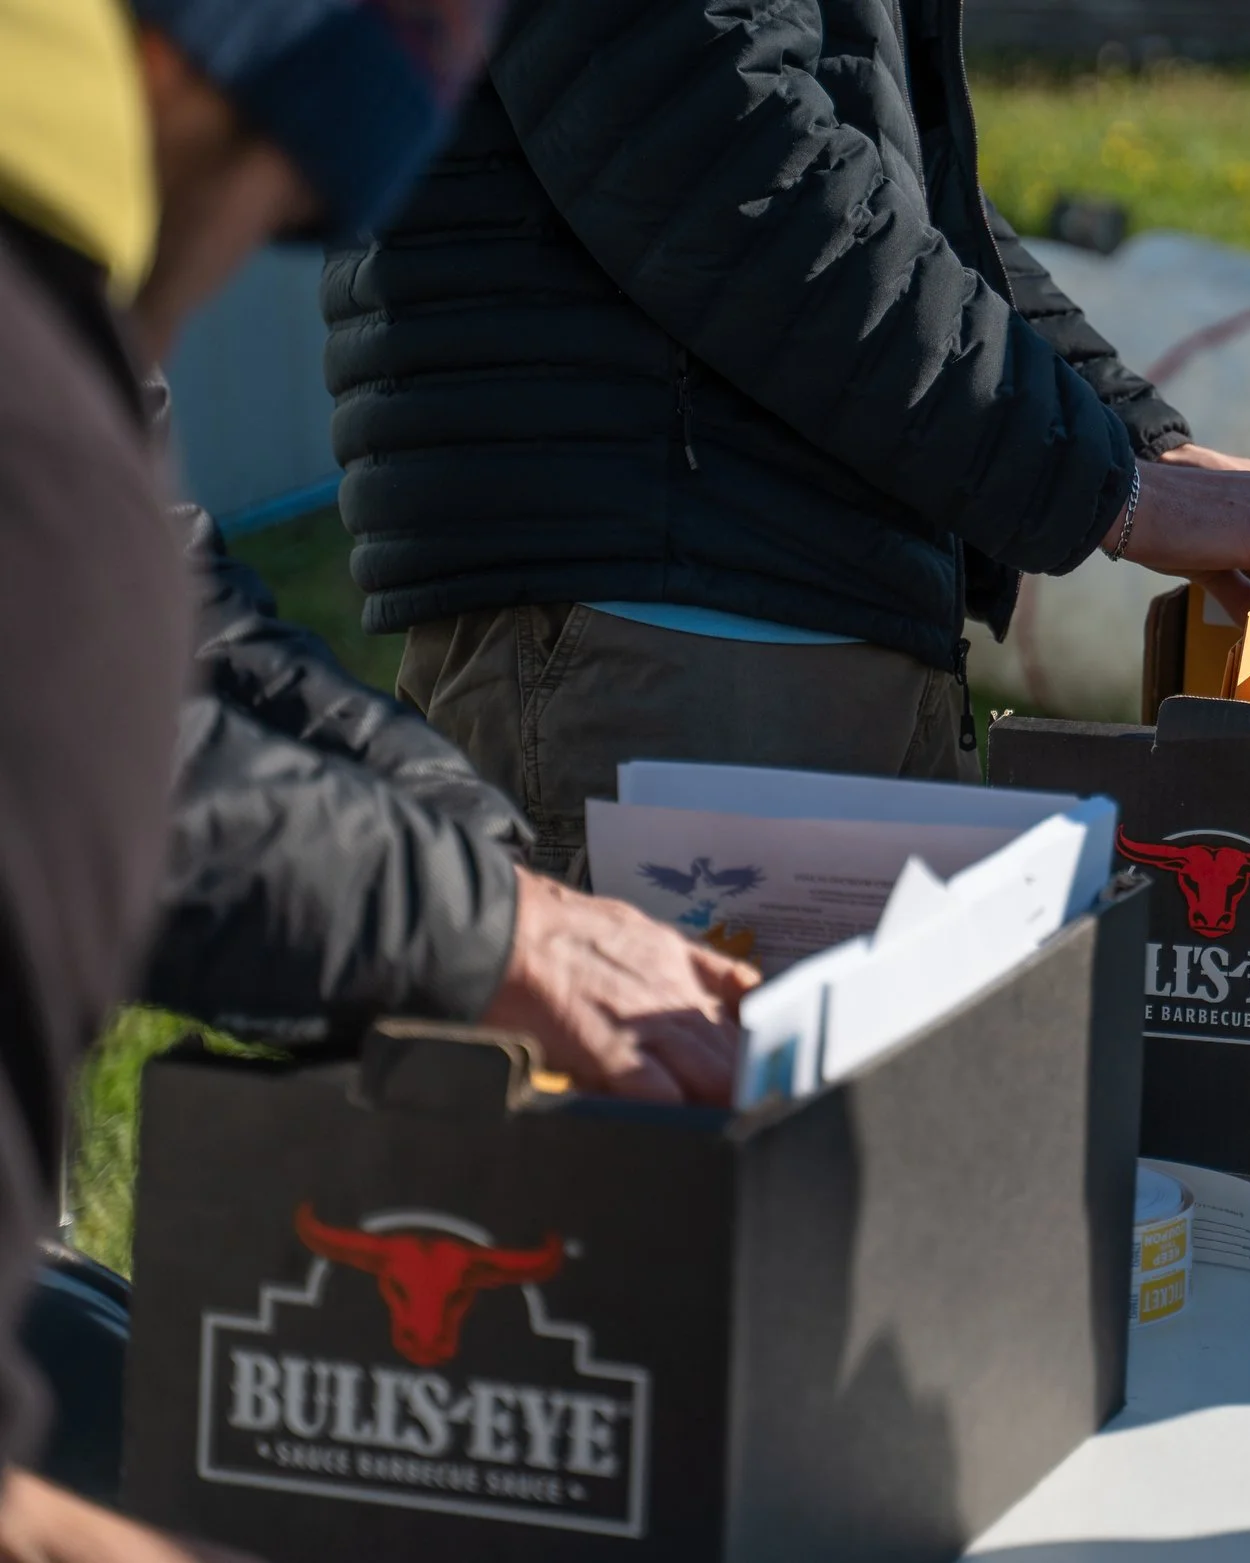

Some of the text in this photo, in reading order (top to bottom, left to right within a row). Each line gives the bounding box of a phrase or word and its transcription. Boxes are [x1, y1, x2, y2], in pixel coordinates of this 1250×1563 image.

[1152, 1247, 1180, 1266] KEEP
[1143, 1279, 1184, 1312] TICKET
[275, 1442, 562, 1503] SAUCE BARBECUE SAUCE
